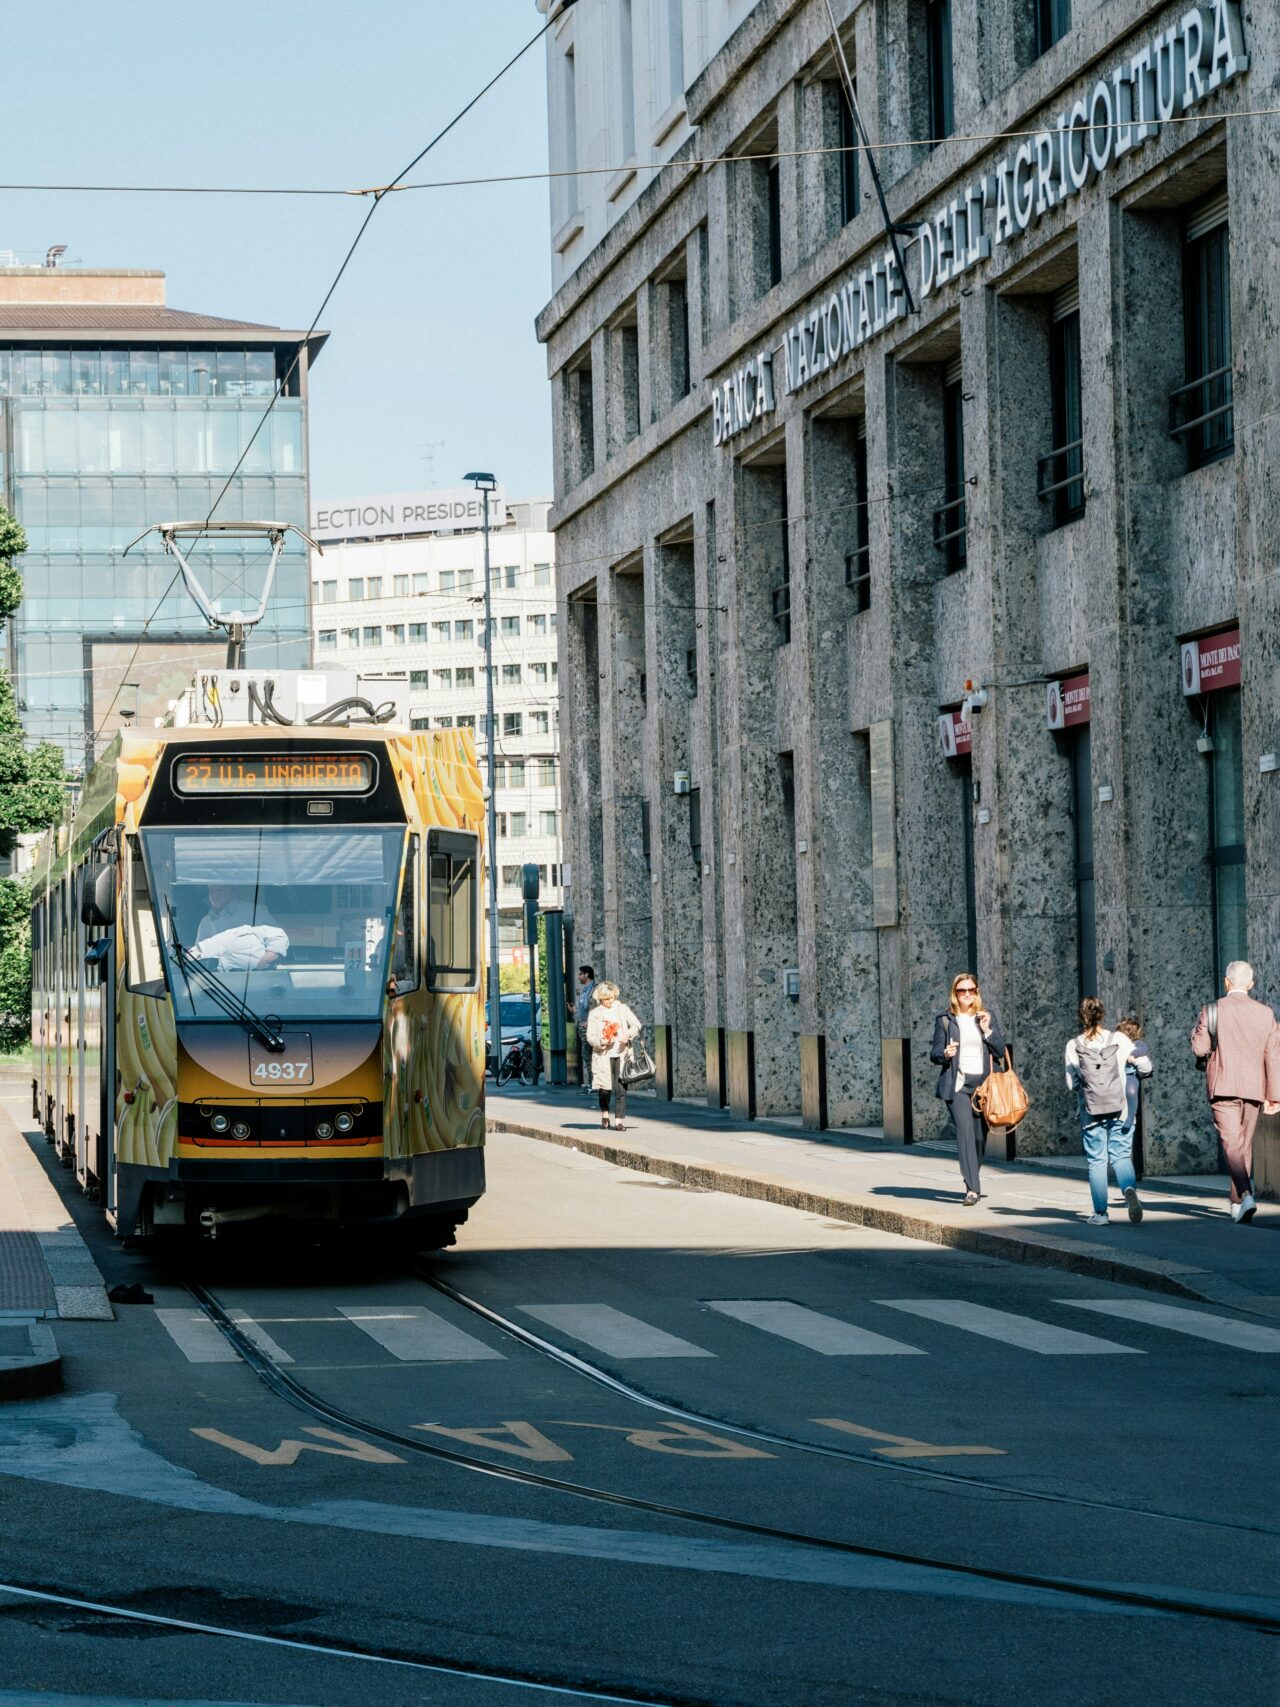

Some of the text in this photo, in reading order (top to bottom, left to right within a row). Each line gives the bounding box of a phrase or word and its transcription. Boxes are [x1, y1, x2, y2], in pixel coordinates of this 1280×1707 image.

[712, 0, 1242, 447] BANCA NAZIONALE DELL'AGRICOLTURA
[186, 766, 211, 788] 27
[264, 764, 361, 787] UNGHERIA
[349, 960, 361, 969] 27
[254, 1062, 309, 1079] 4937
